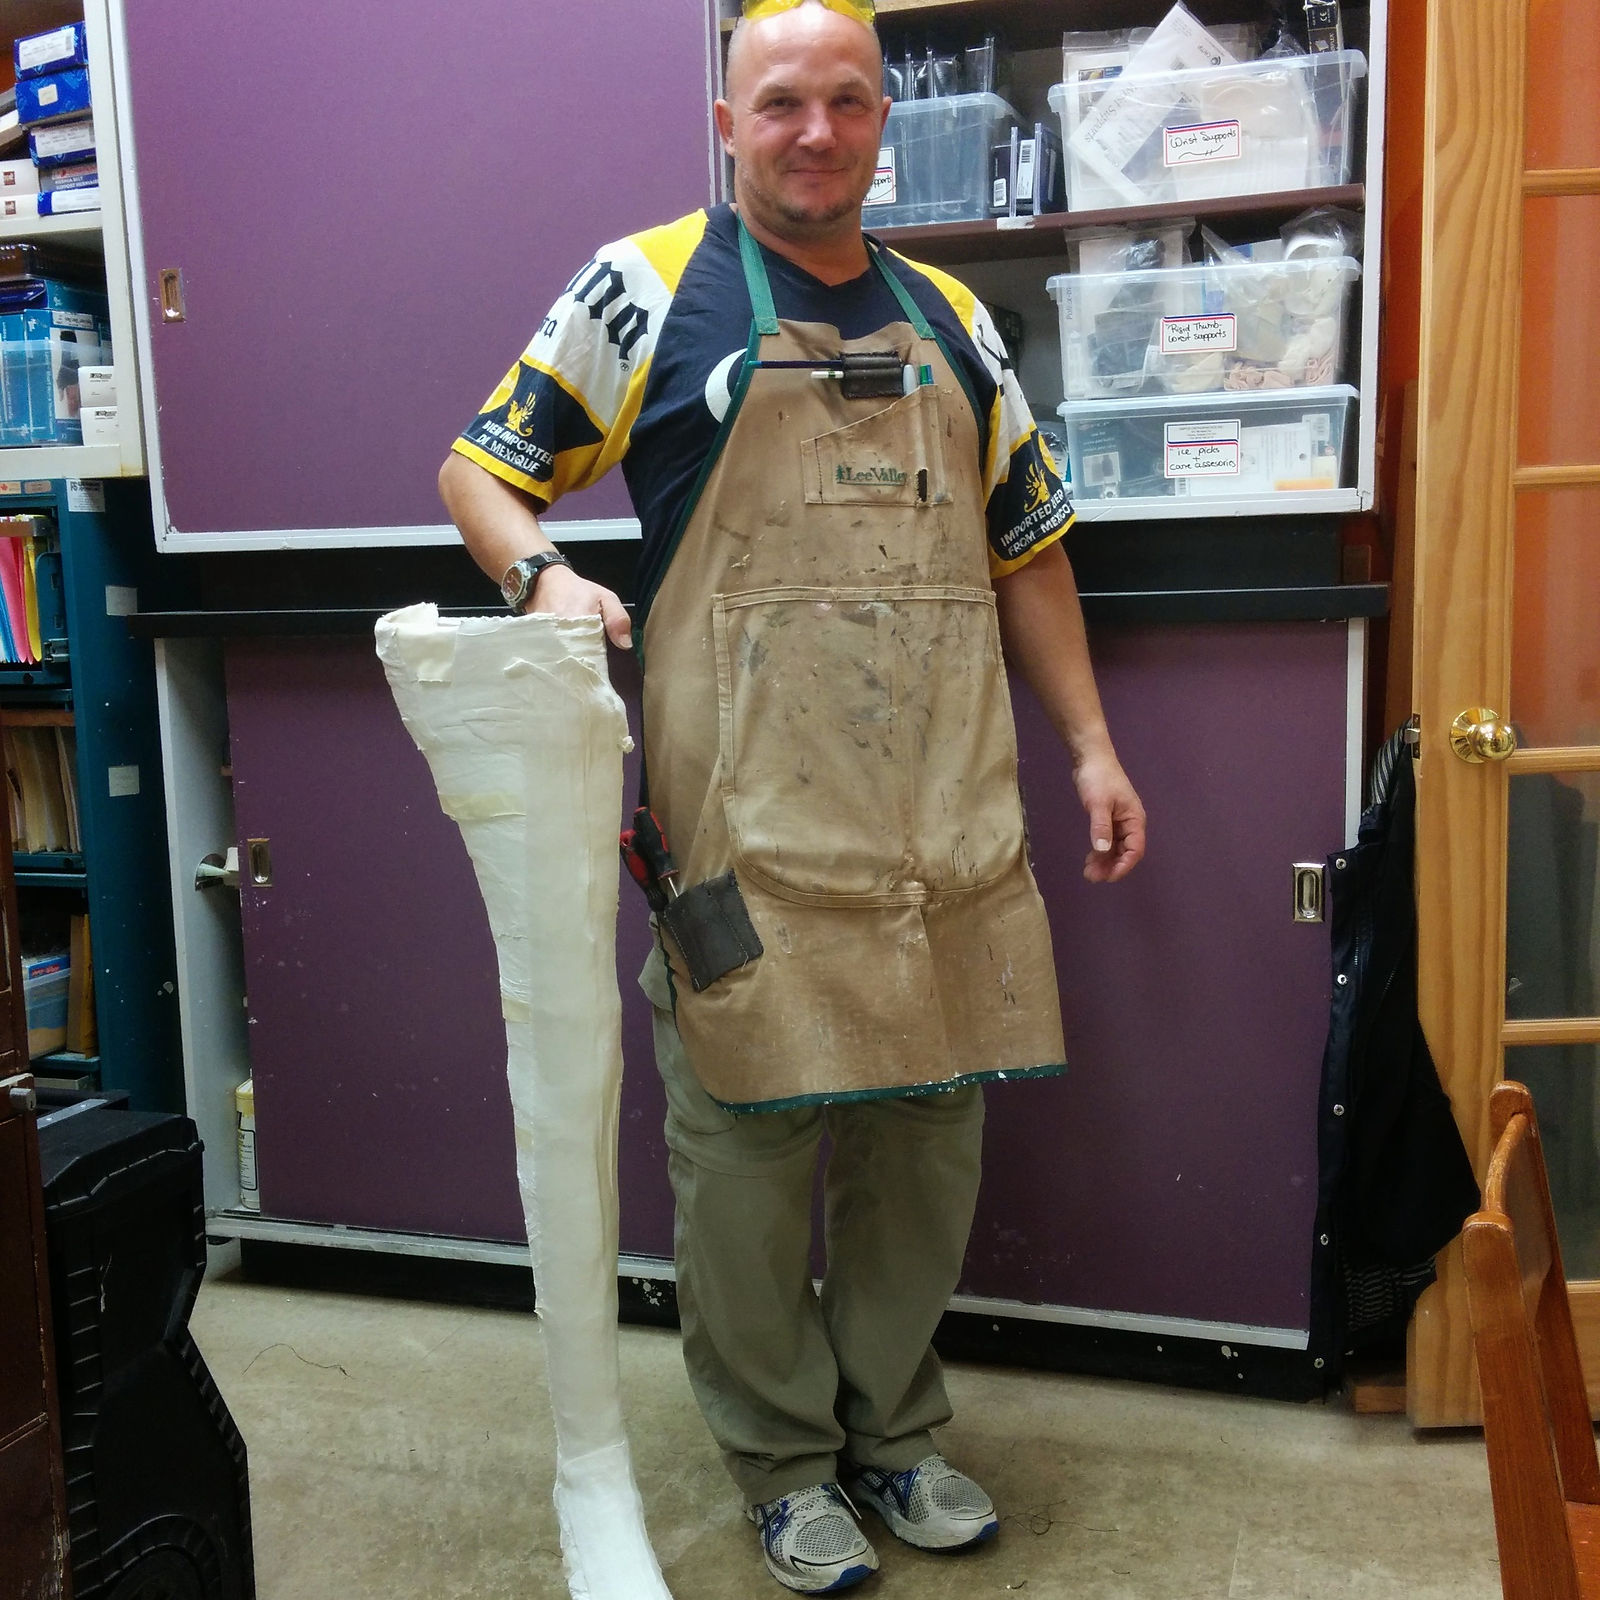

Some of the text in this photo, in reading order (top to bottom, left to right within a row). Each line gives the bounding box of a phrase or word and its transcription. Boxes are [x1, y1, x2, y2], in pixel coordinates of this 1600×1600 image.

[1170, 128, 1237, 149] Wrist Supports
[1167, 323, 1190, 334] Rigid
[490, 440, 541, 473] MEXIQUE
[1178, 445, 1220, 456] ice picks
[1000, 503, 1051, 548] IMPORTED
[1008, 530, 1036, 557] FROM
